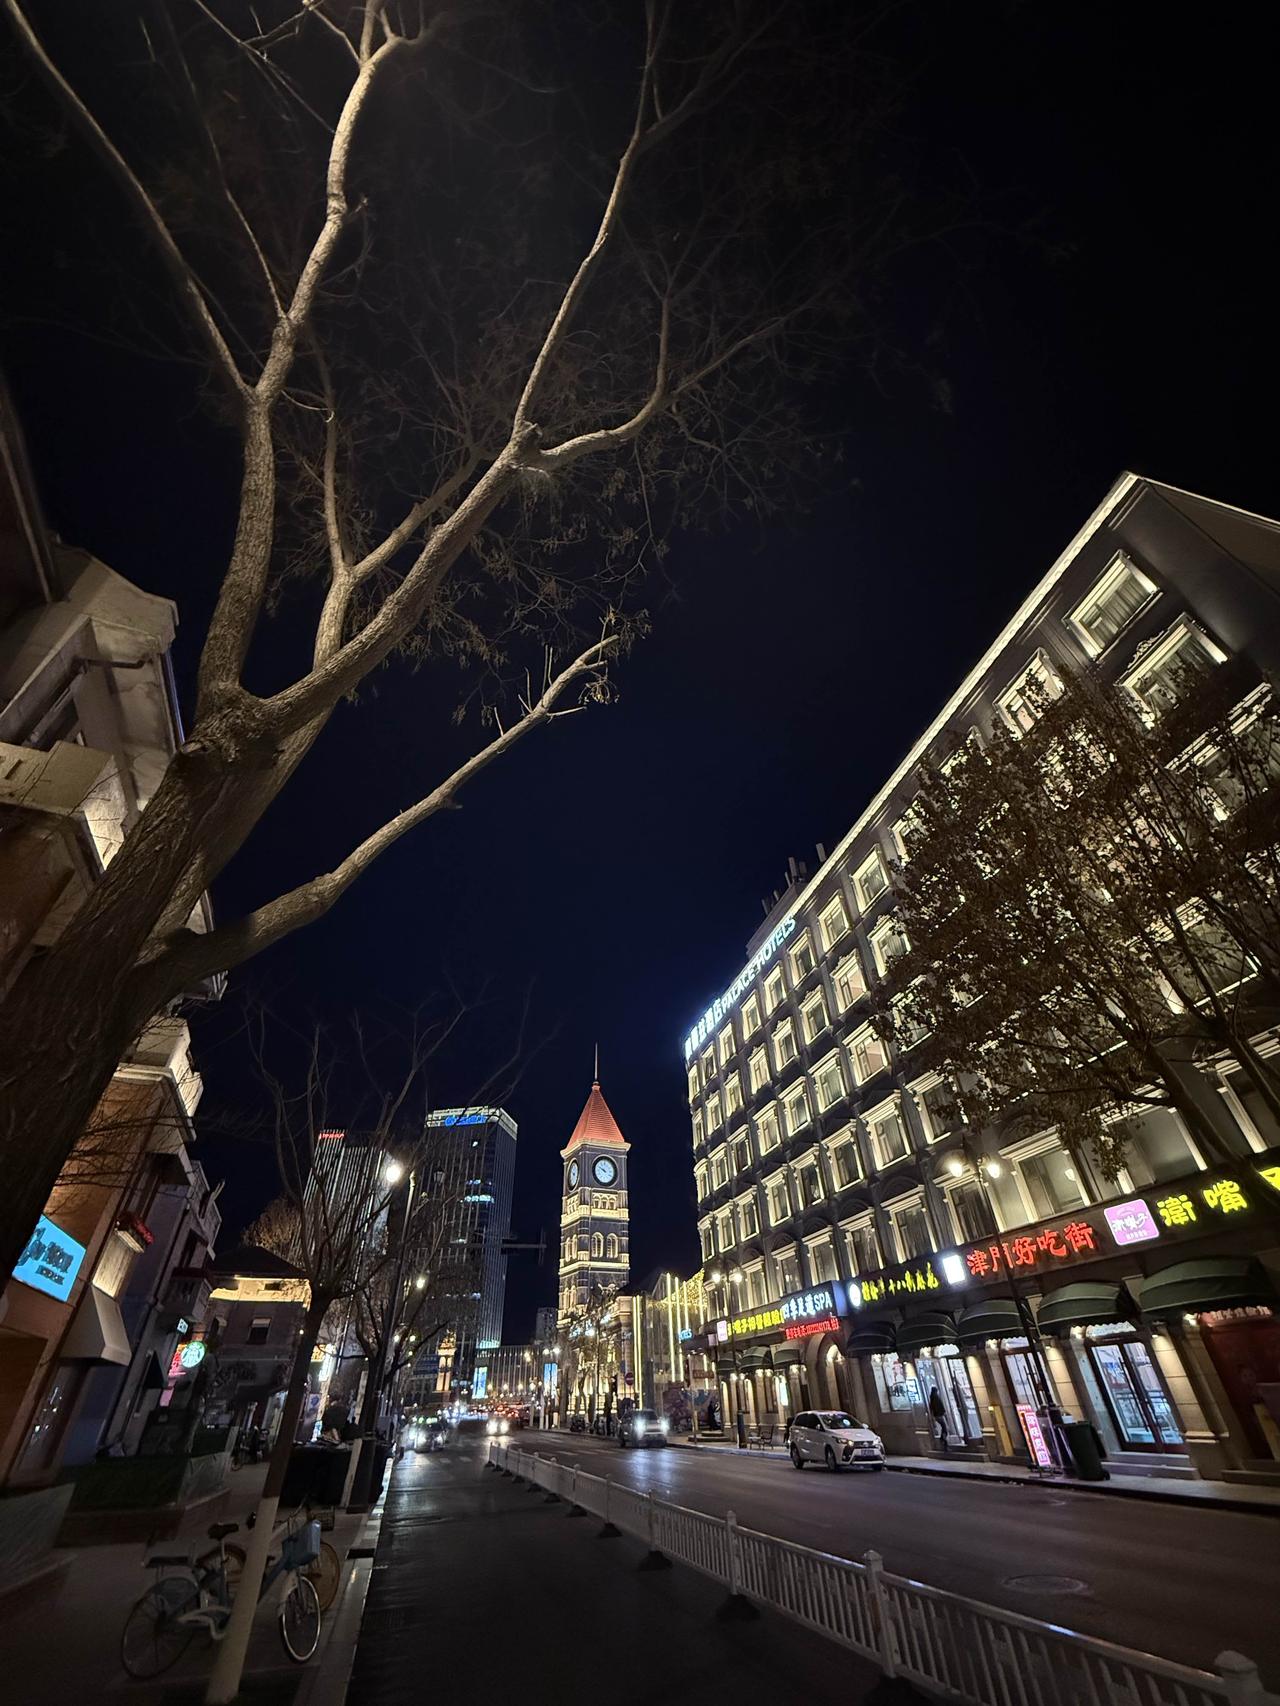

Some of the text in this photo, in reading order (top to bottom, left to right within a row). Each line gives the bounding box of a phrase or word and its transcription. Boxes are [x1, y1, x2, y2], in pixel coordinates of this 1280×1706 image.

[757, 915, 796, 971] HOTELS
[966, 1222, 1095, 1277] 津門好吃街
